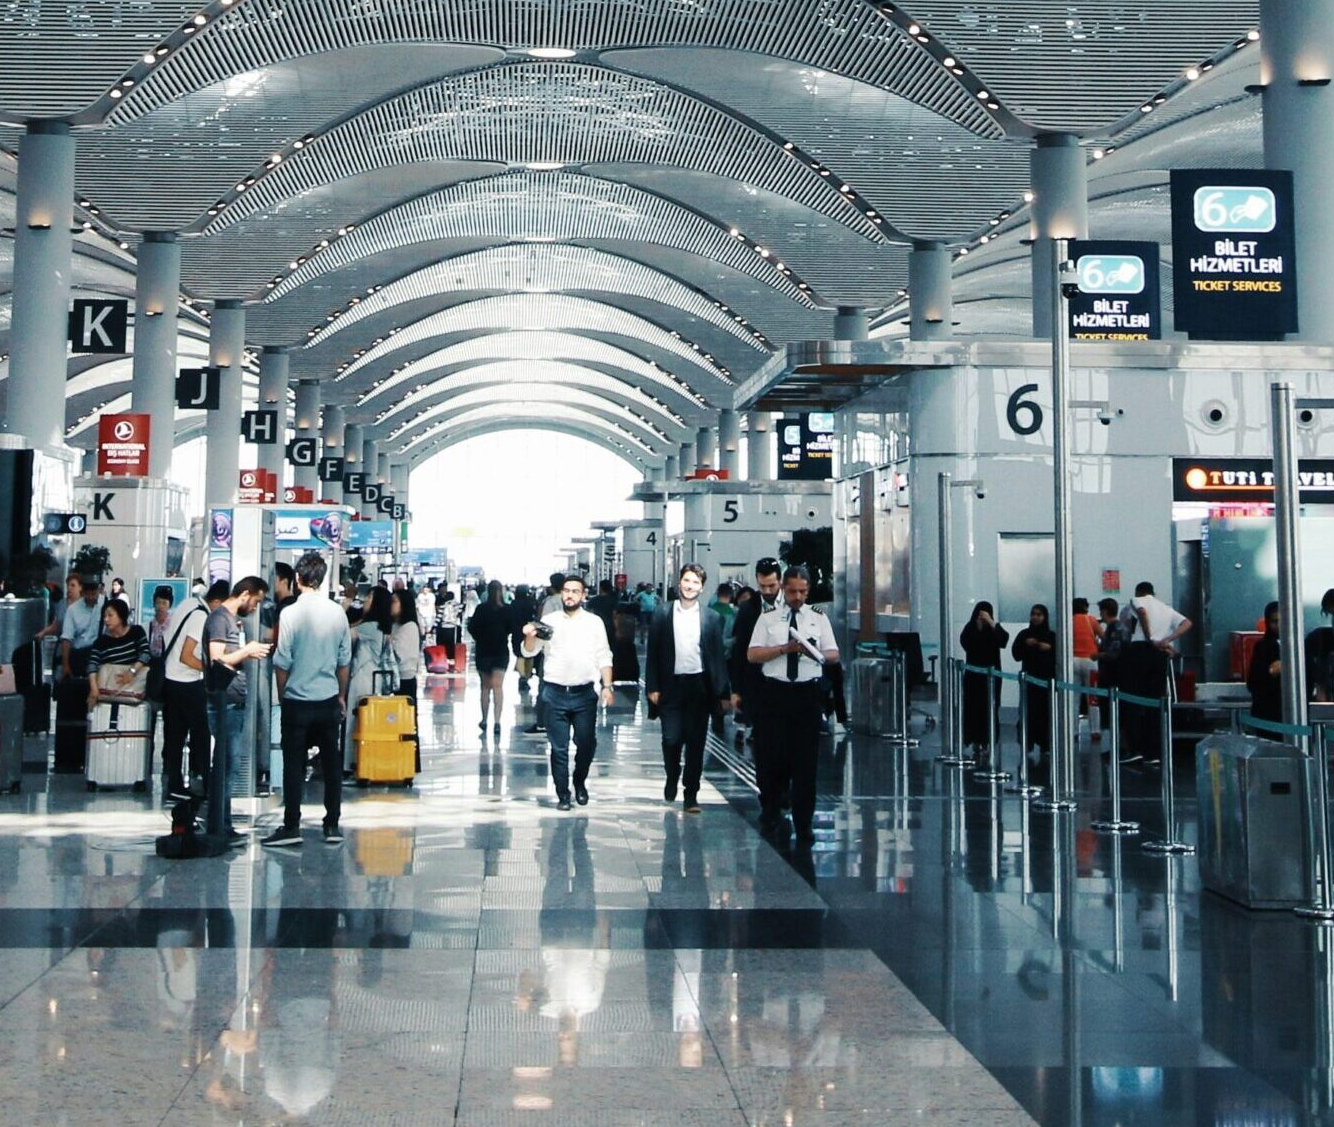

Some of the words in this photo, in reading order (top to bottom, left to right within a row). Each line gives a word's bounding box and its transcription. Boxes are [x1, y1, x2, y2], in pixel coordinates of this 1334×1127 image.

[1202, 192, 1227, 227] 6
[1215, 238, 1258, 256] BİLET
[1083, 259, 1104, 289] 6
[1190, 255, 1283, 274] HİZMETLERİ
[1193, 280, 1230, 291] TICKET
[1233, 281, 1281, 292] SERVICES
[1093, 298, 1129, 313] BİLET
[82, 306, 114, 347] K
[1073, 312, 1150, 328] HİZMETLERİ
[190, 373, 208, 405] J
[1007, 384, 1043, 436] 6
[249, 414, 271, 439] H
[293, 441, 311, 464] G
[325, 460, 337, 479] F
[349, 475, 360, 492] E
[366, 486, 378, 502] D
[93, 492, 116, 521] K
[381, 497, 392, 512] C
[393, 505, 402, 518] B
[723, 500, 739, 523] 5
[646, 531, 657, 546] 4
